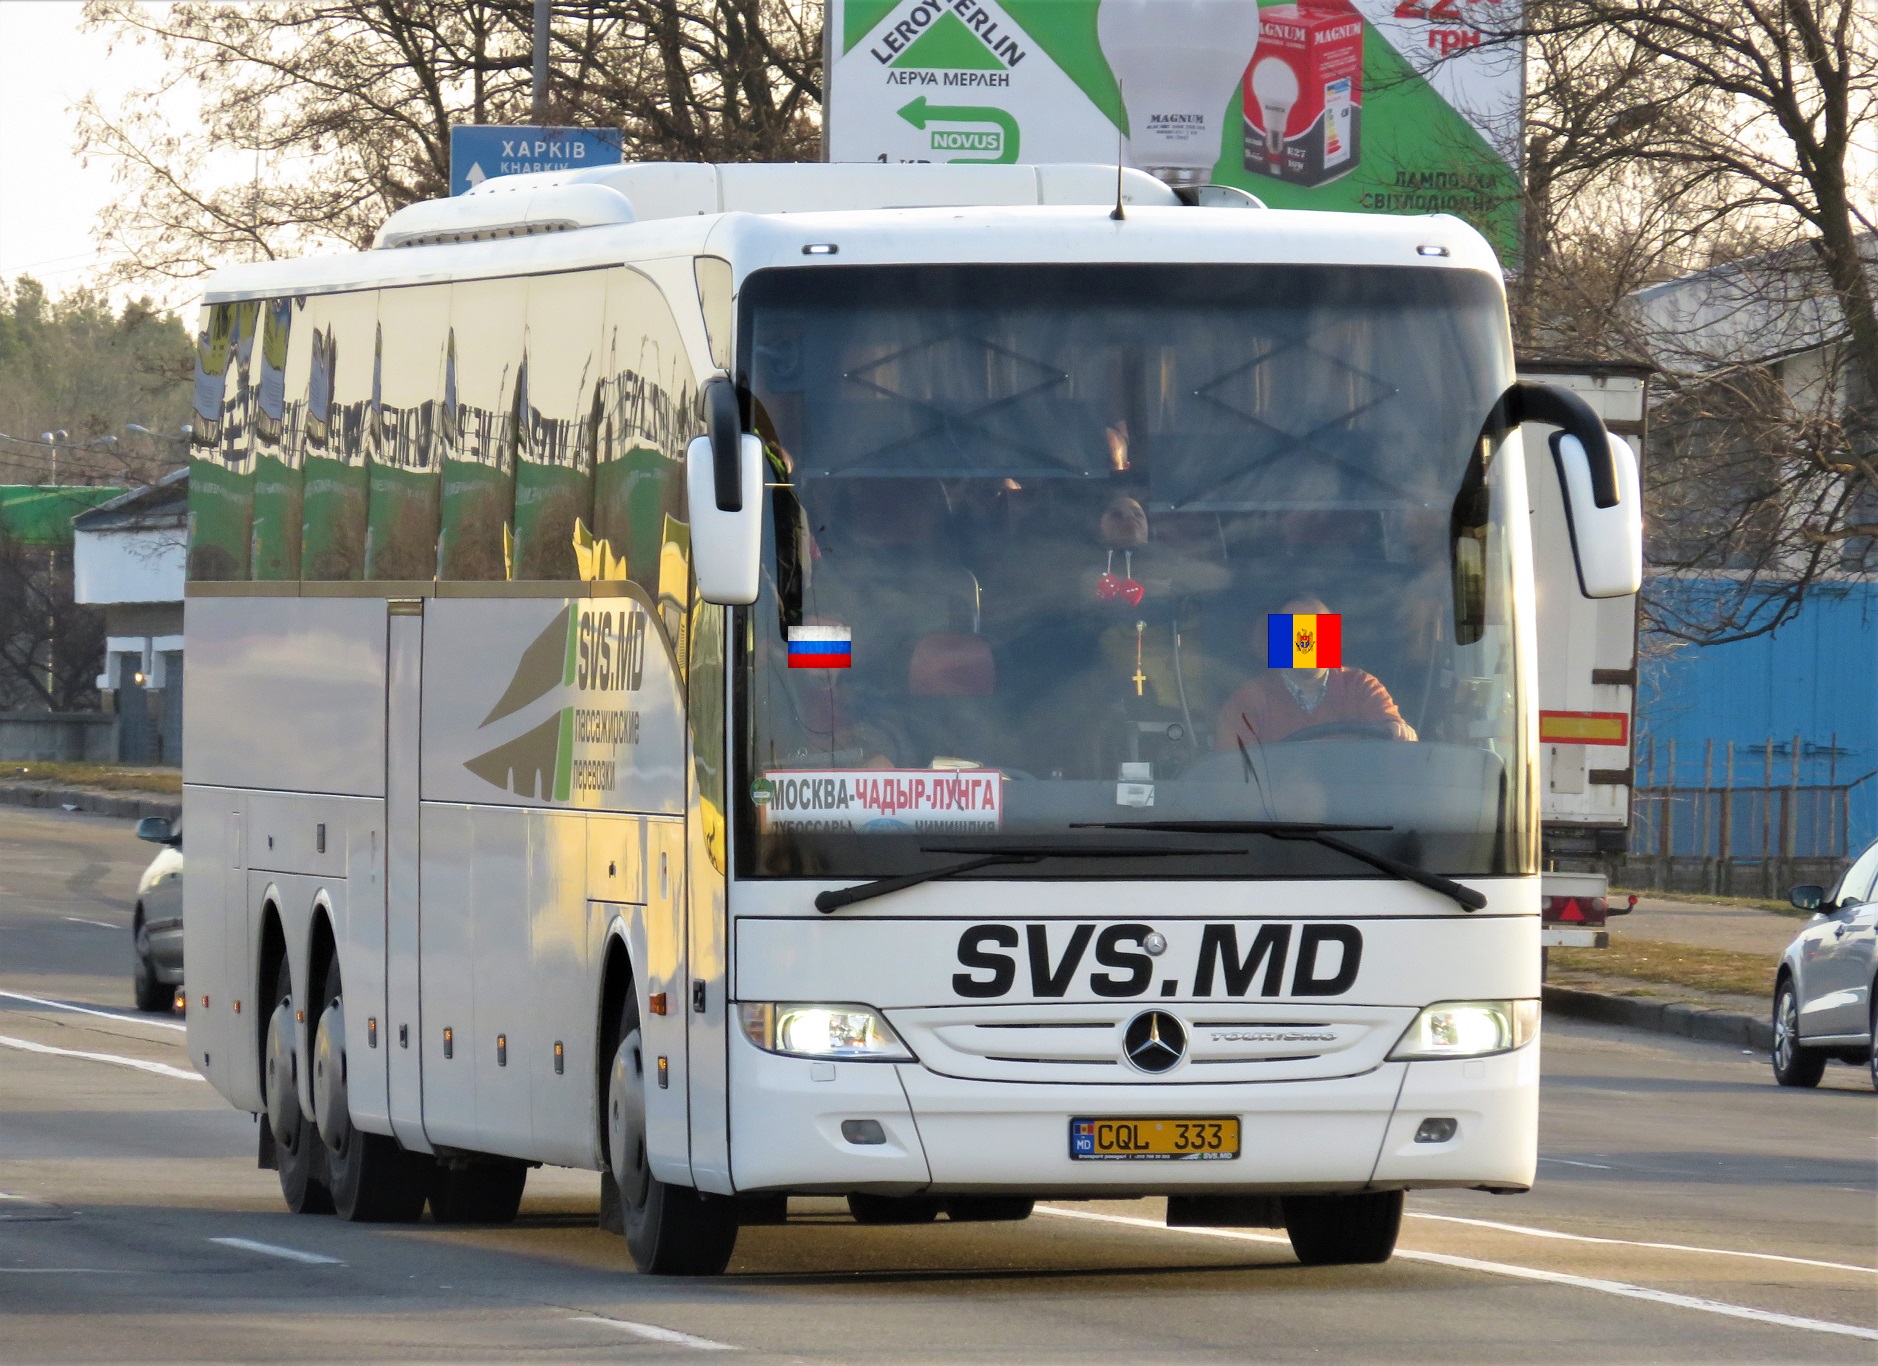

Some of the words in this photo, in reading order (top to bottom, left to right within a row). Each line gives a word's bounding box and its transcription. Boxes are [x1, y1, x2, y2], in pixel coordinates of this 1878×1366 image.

[870, 0, 942, 65] LEROY
[950, 0, 1027, 67] ERLIN
[1259, 21, 1306, 42] AGNUM
[1314, 21, 1362, 45] MAGNUM
[943, 73, 1010, 86] МЕРЛЕН
[1151, 114, 1204, 123] MAGNUM
[501, 140, 586, 159] ХАРКІВ
[933, 133, 998, 149] NOVUS
[578, 611, 646, 691] SVS.MD
[574, 709, 640, 757] пассажирские
[573, 759, 616, 802] перевозки
[952, 923, 1364, 998] SVS.MD
[1076, 1140, 1091, 1150] MD
[1098, 1124, 1150, 1150] CQL
[1174, 1124, 1223, 1150] 333
